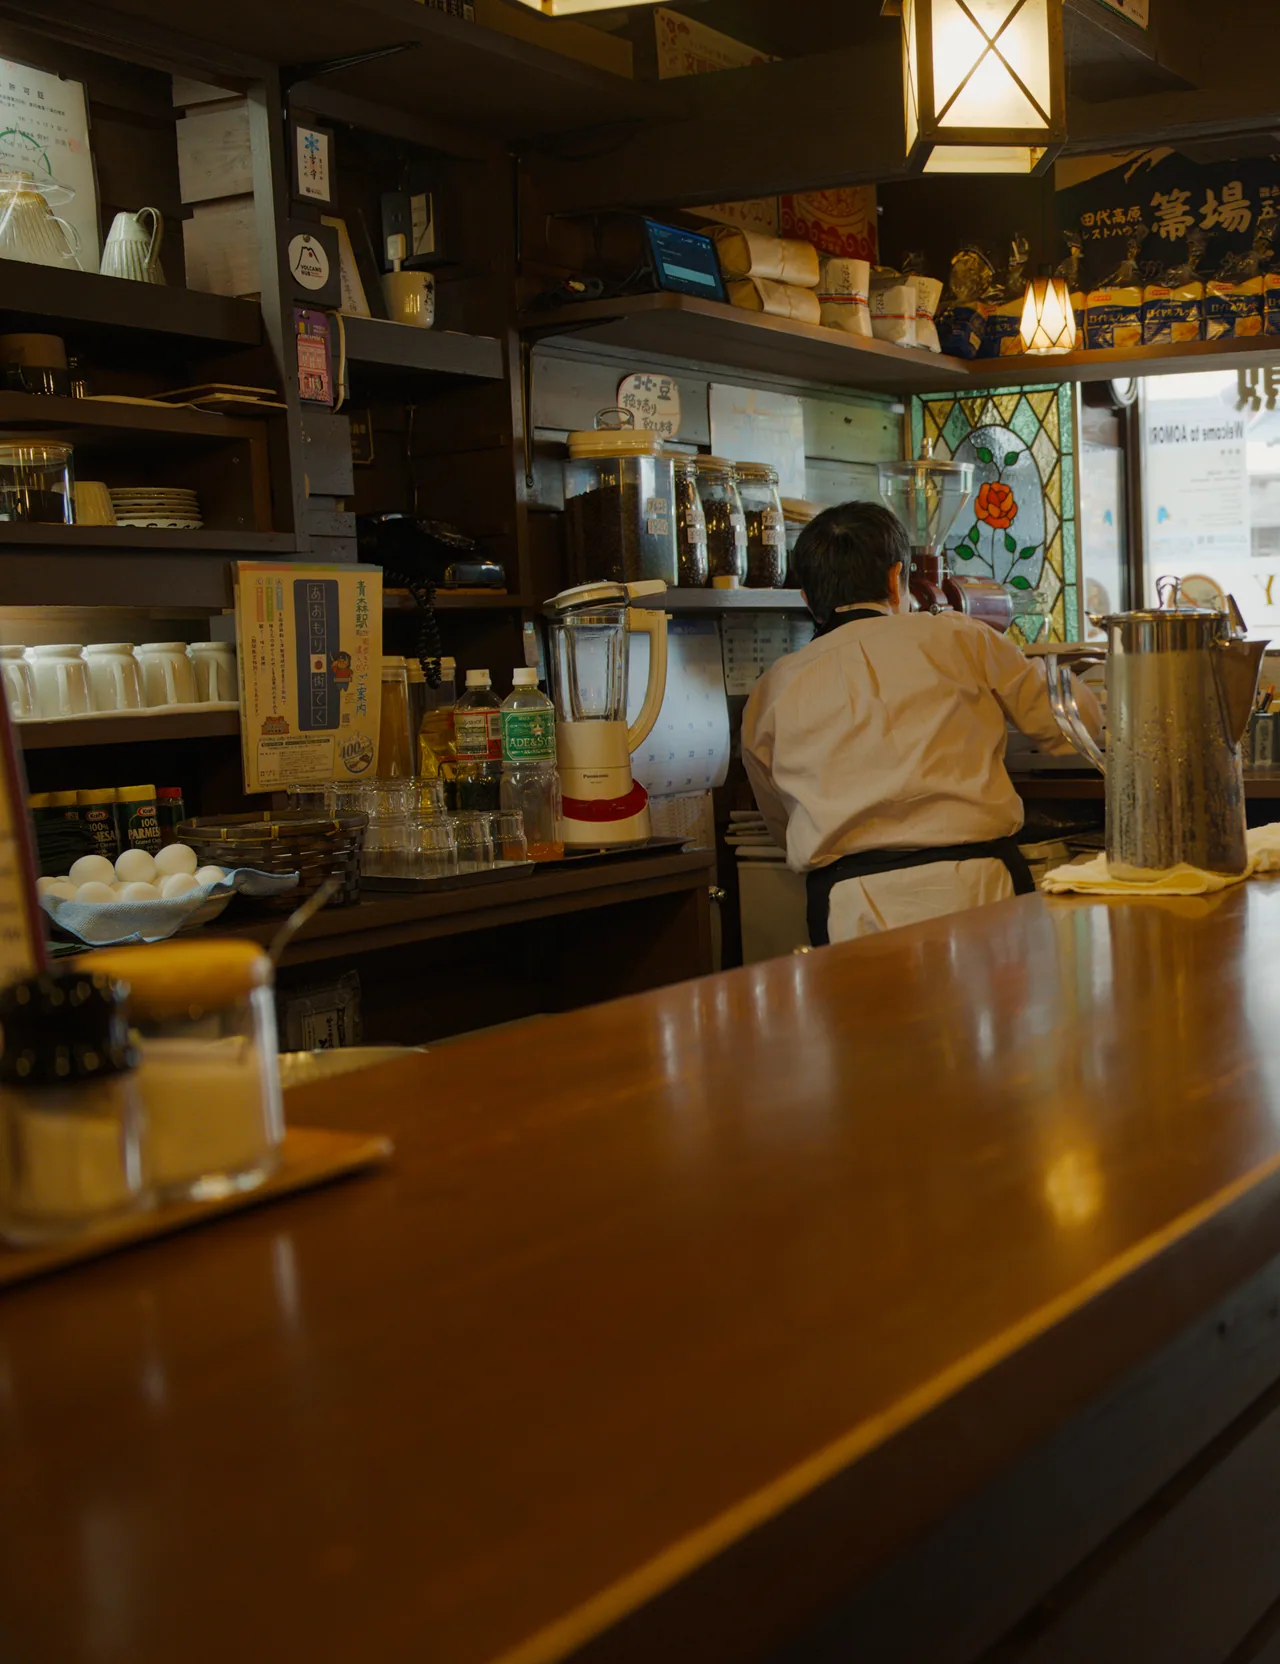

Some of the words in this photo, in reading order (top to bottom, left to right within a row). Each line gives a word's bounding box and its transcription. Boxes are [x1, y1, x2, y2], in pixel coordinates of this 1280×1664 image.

[1080, 205, 1143, 227] 田代高原
[300, 264, 322, 273] VOLCANO
[356, 580, 369, 629] 青森駅
[357, 673, 368, 716] ご案内
